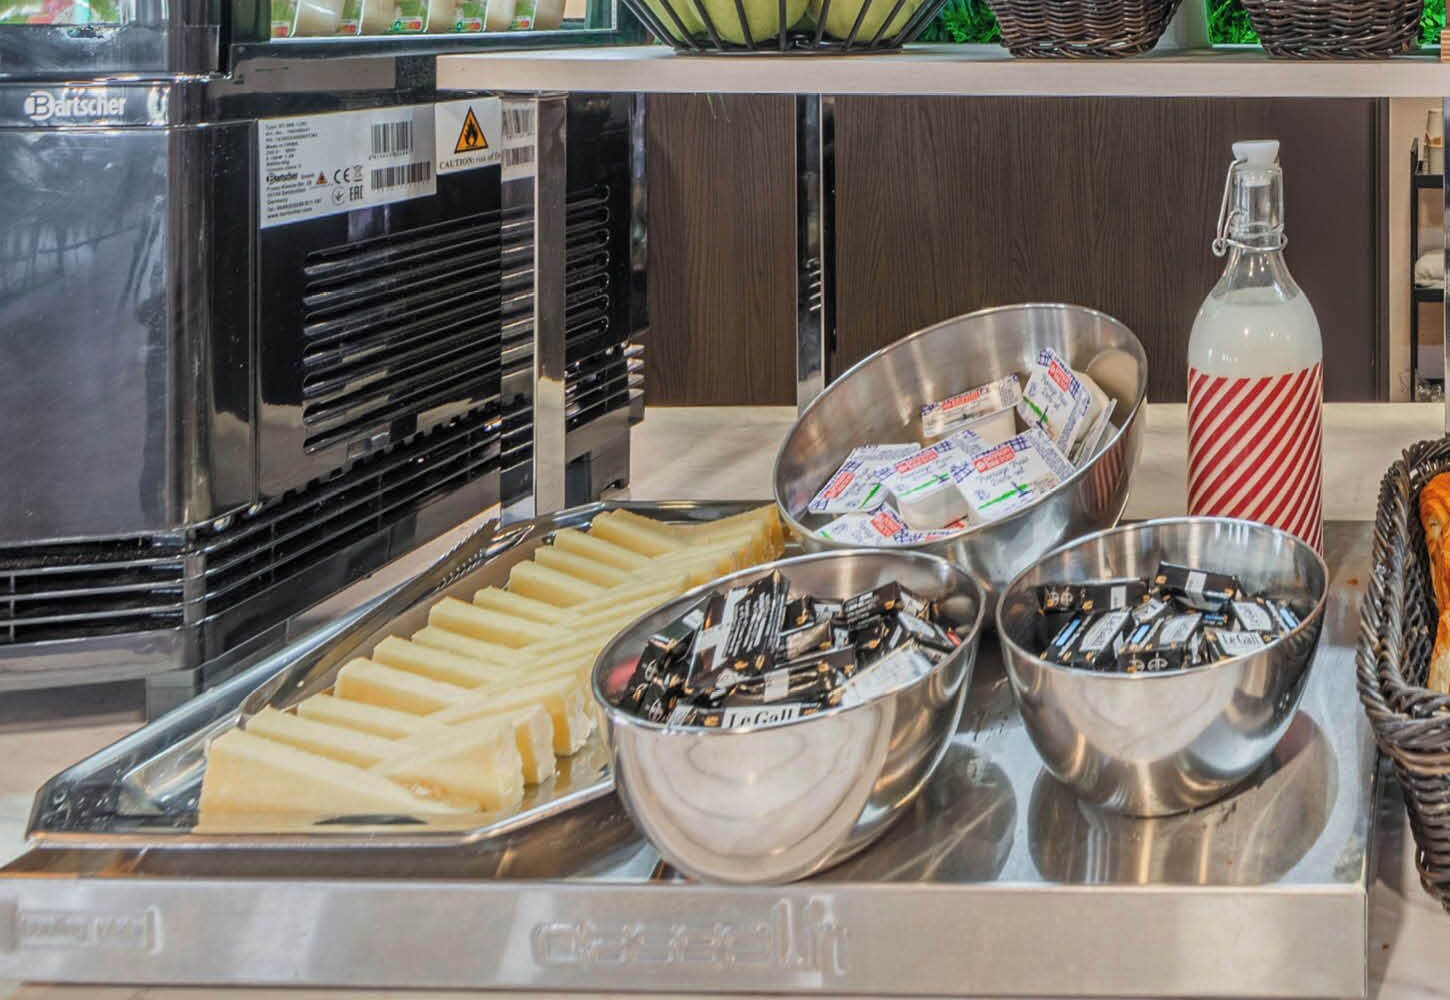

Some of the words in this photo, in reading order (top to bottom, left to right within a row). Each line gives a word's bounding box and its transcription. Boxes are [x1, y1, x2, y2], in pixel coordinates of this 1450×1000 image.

[25, 90, 127, 122] Bartscher
[728, 713, 751, 729] Le
[753, 708, 793, 725] Gall
